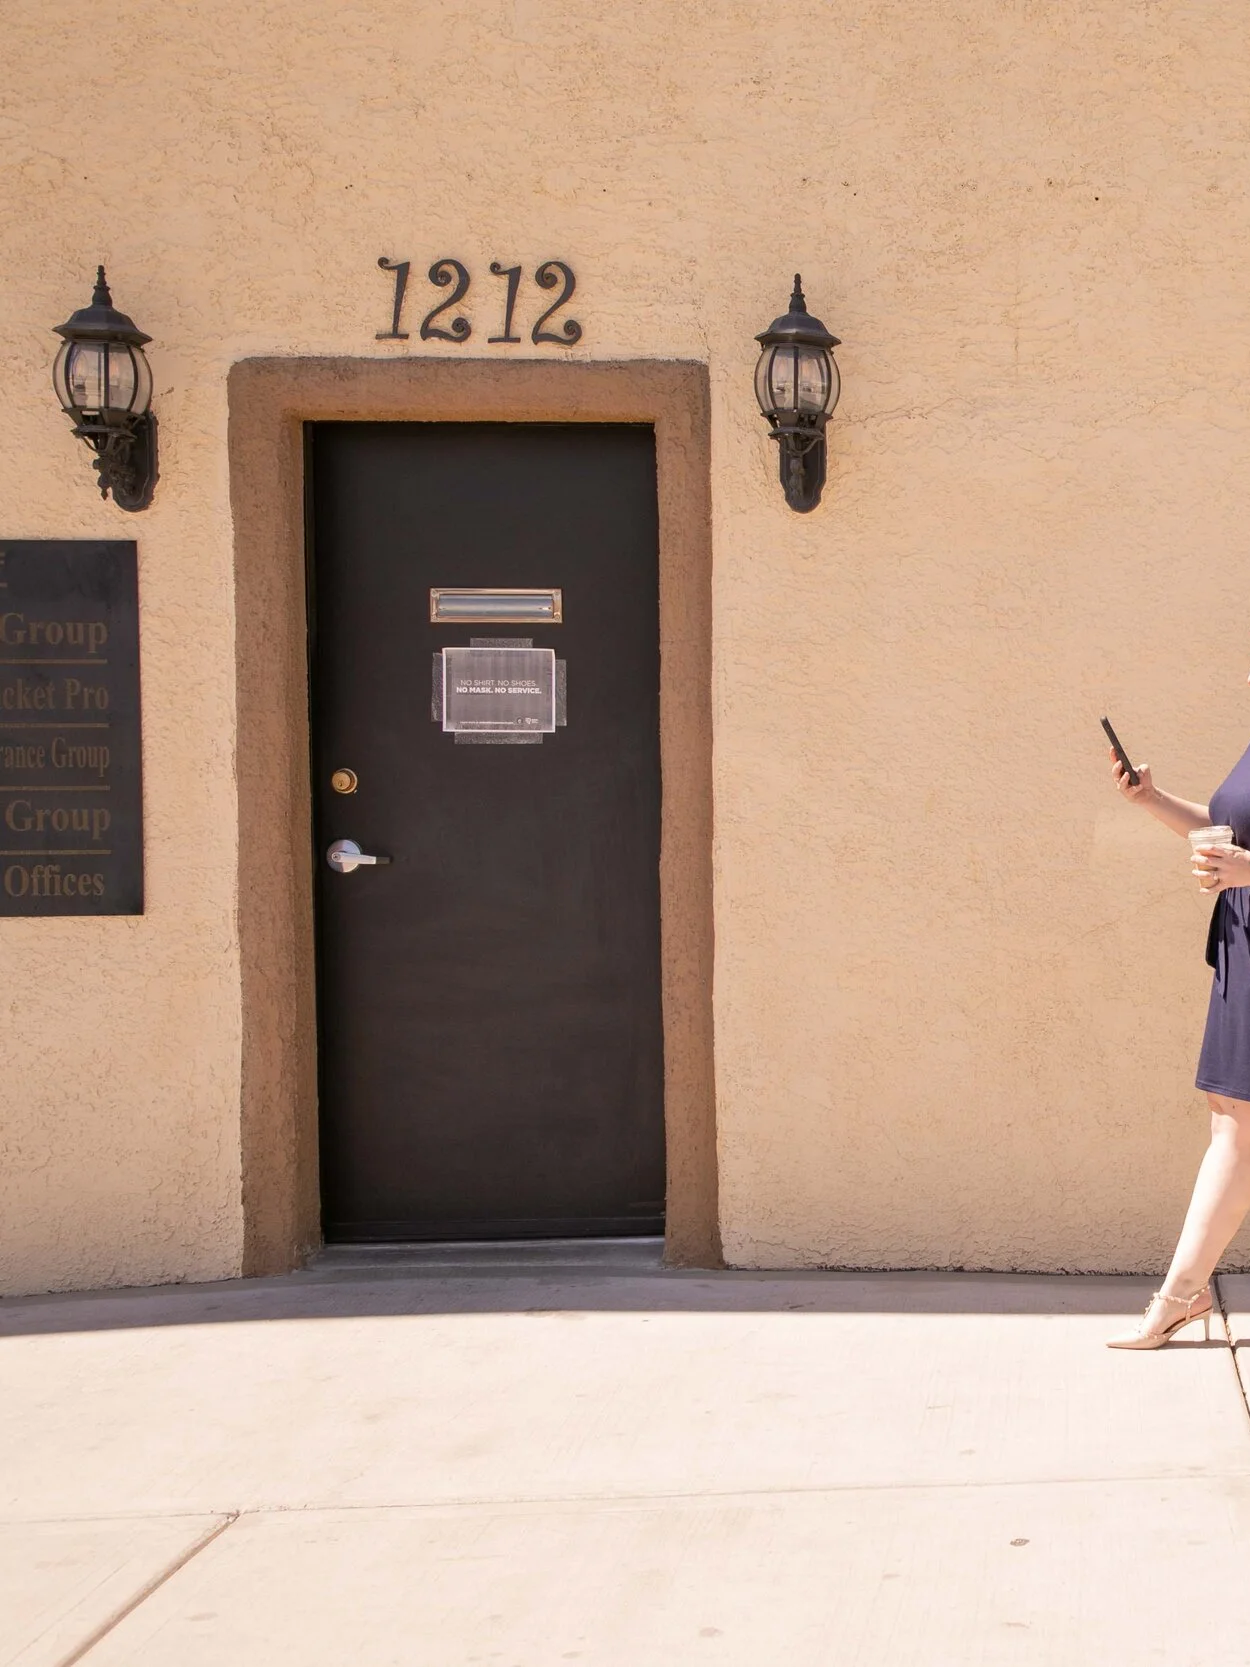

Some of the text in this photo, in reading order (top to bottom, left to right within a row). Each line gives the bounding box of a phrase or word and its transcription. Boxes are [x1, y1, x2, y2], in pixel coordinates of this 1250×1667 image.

[375, 256, 583, 346] 1212
[0, 612, 108, 653] Group
[63, 678, 109, 710] Pro
[51, 736, 110, 778] Group
[5, 799, 111, 840] Group
[4, 864, 105, 897] Offices
